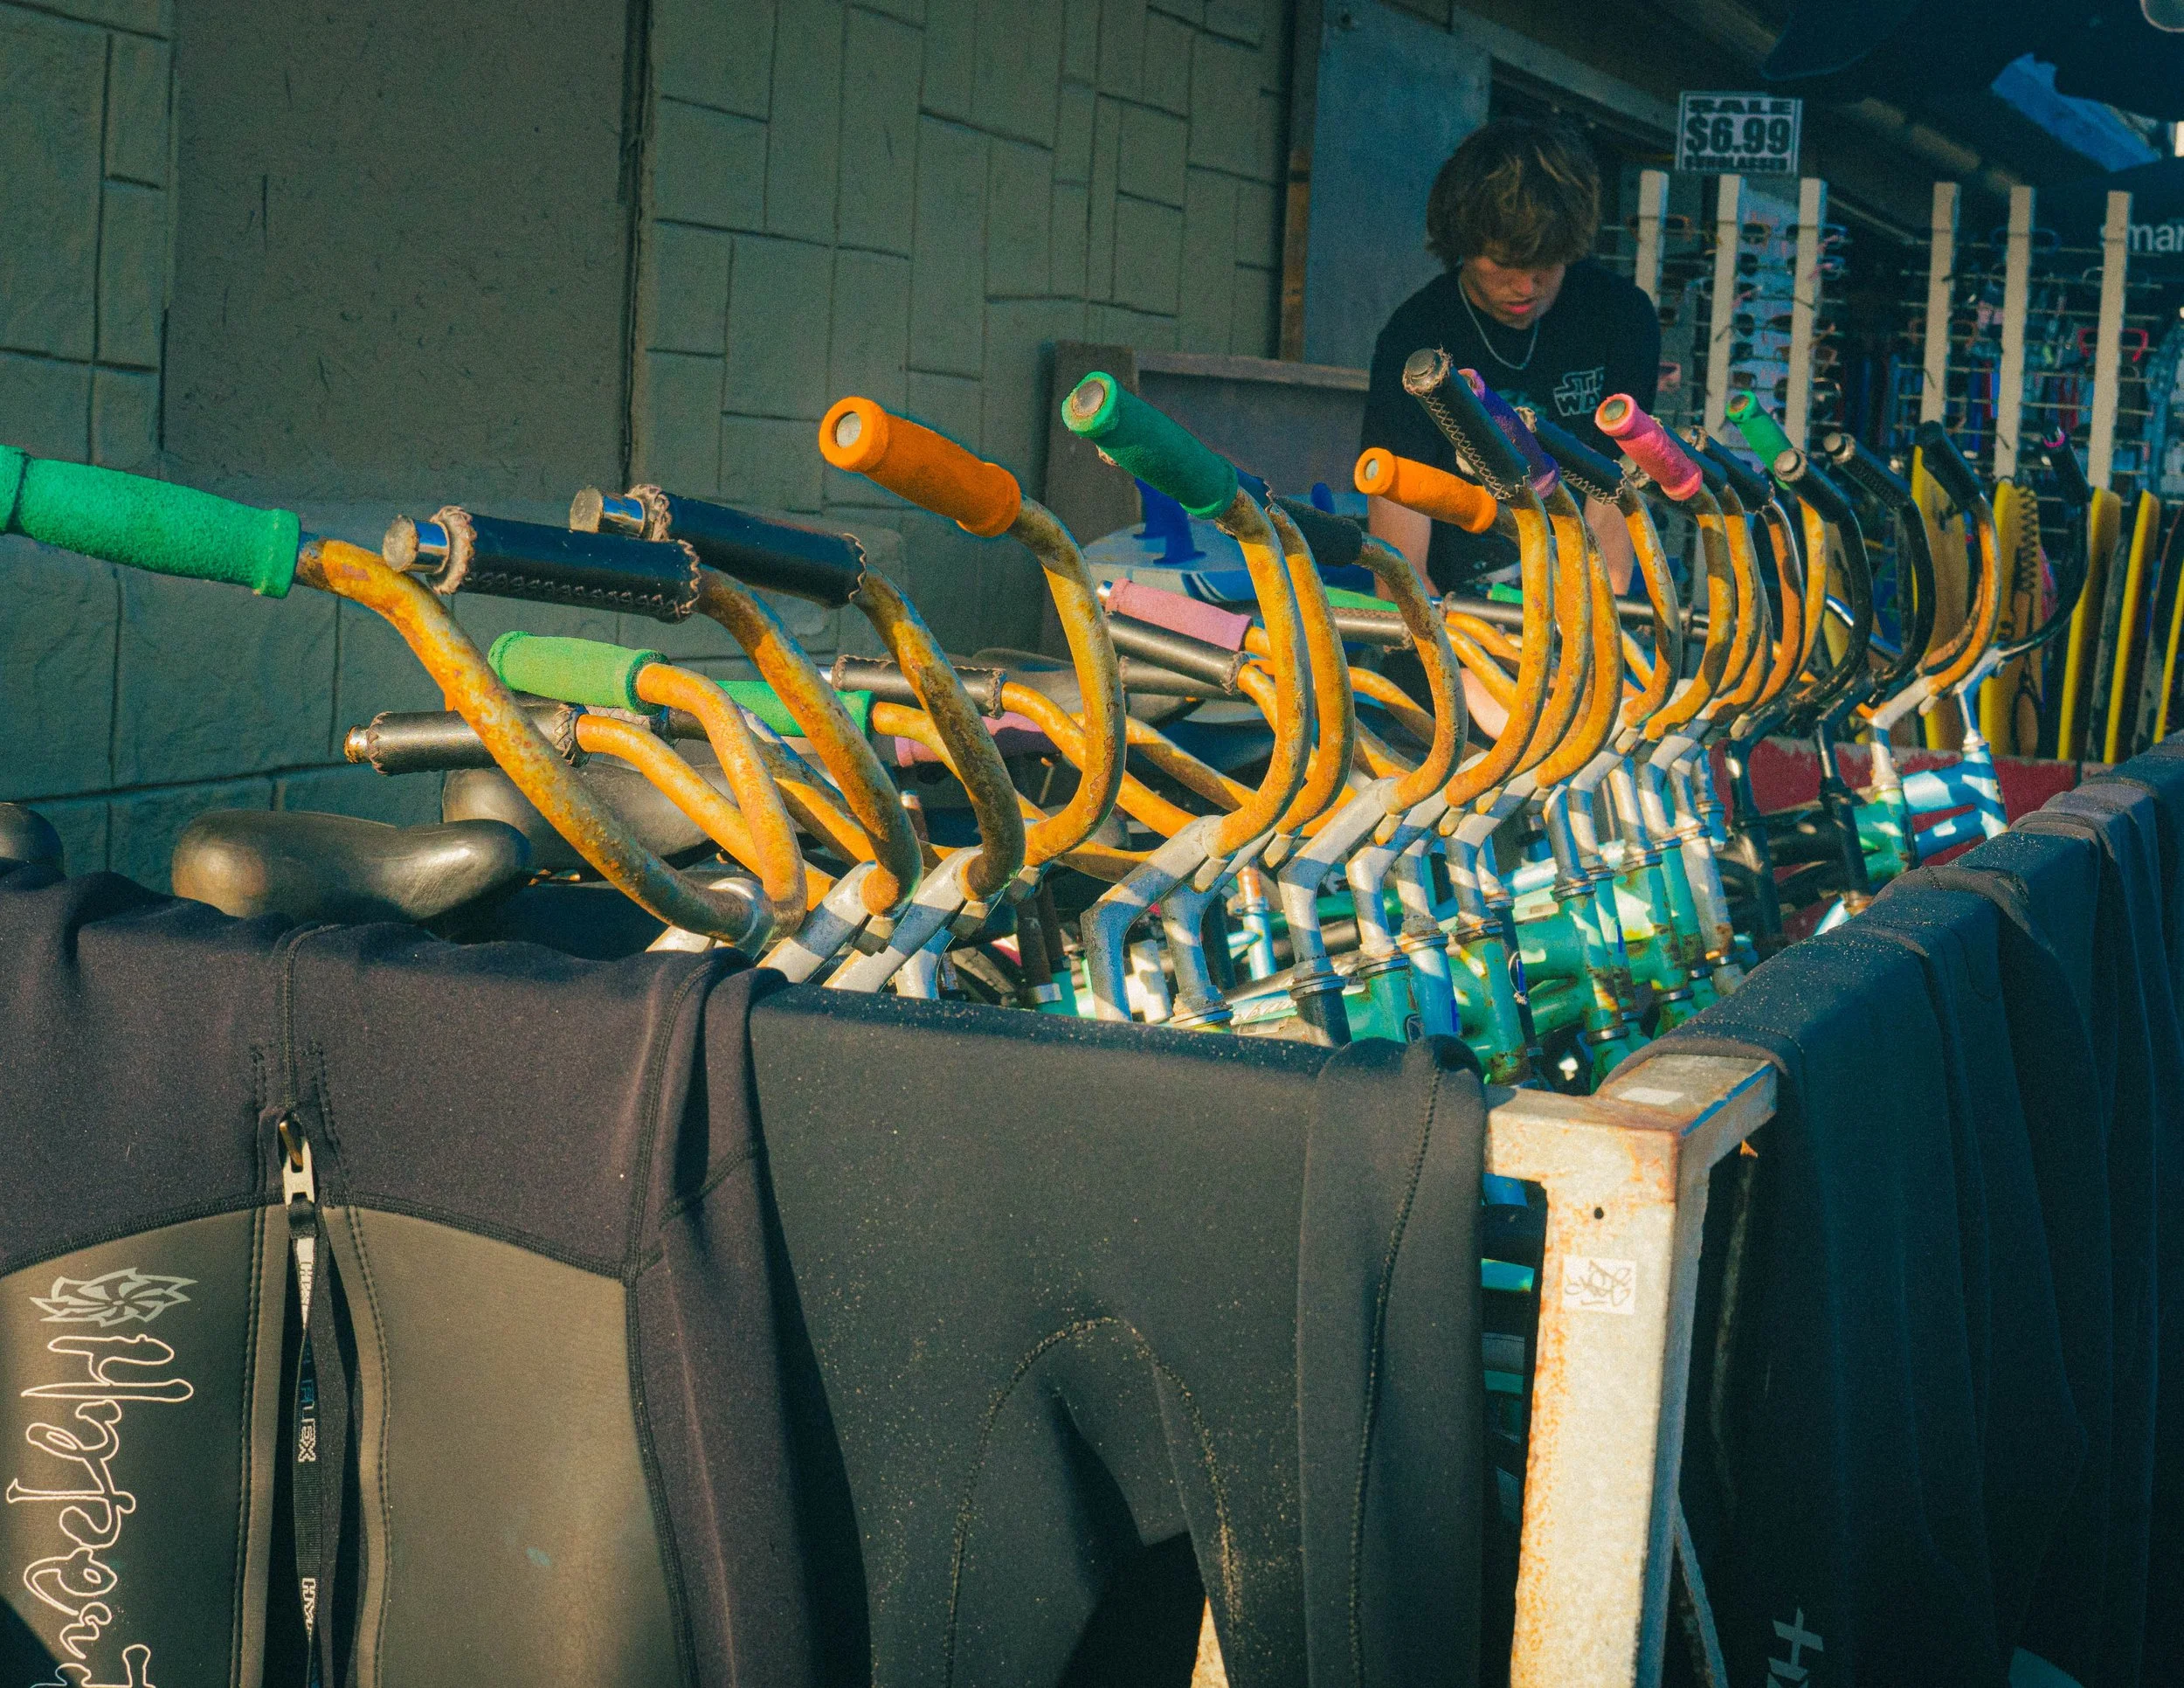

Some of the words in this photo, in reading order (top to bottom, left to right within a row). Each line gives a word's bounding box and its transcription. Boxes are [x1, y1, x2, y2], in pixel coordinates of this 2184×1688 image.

[1688, 99, 1791, 114] SALE
[1685, 112, 1791, 156] $6.99
[2099, 222, 2184, 254] mar
[7, 1333, 195, 1688] Hyper
